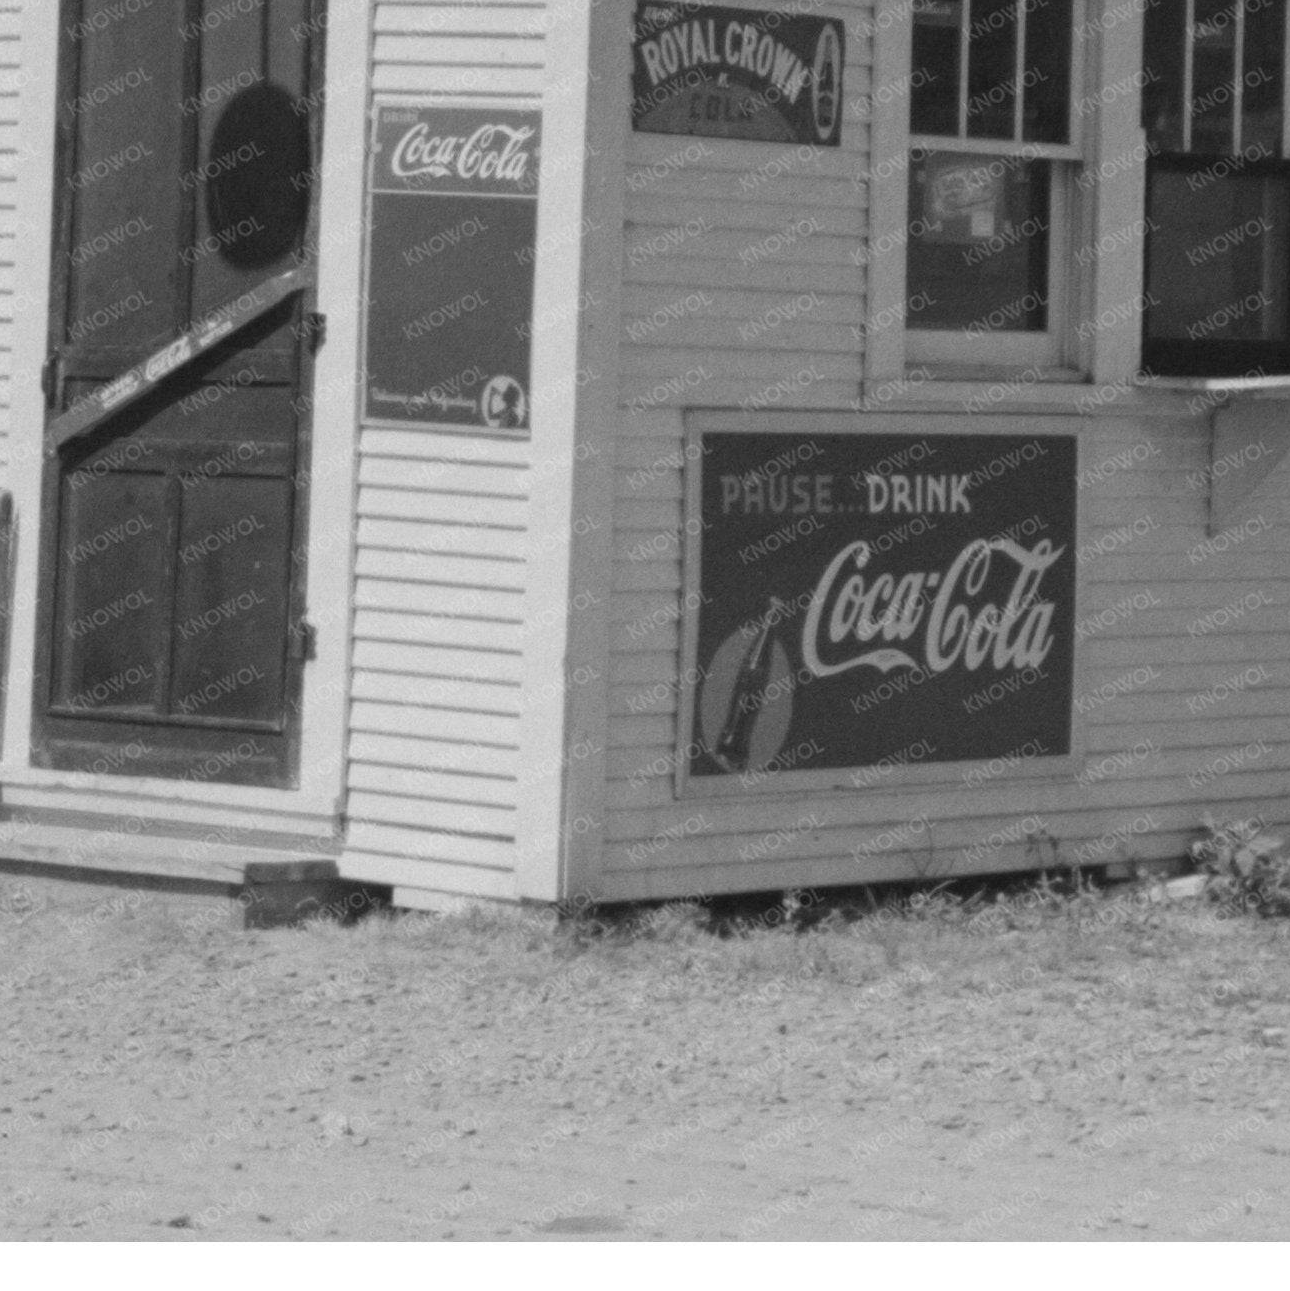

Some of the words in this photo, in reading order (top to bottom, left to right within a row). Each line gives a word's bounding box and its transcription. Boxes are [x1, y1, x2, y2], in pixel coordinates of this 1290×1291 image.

[641, 19, 721, 86] ROYAL
[724, 20, 809, 105] CROWN
[391, 122, 536, 180] Coca-Cola
[802, 537, 1068, 678] Coca-Cola
